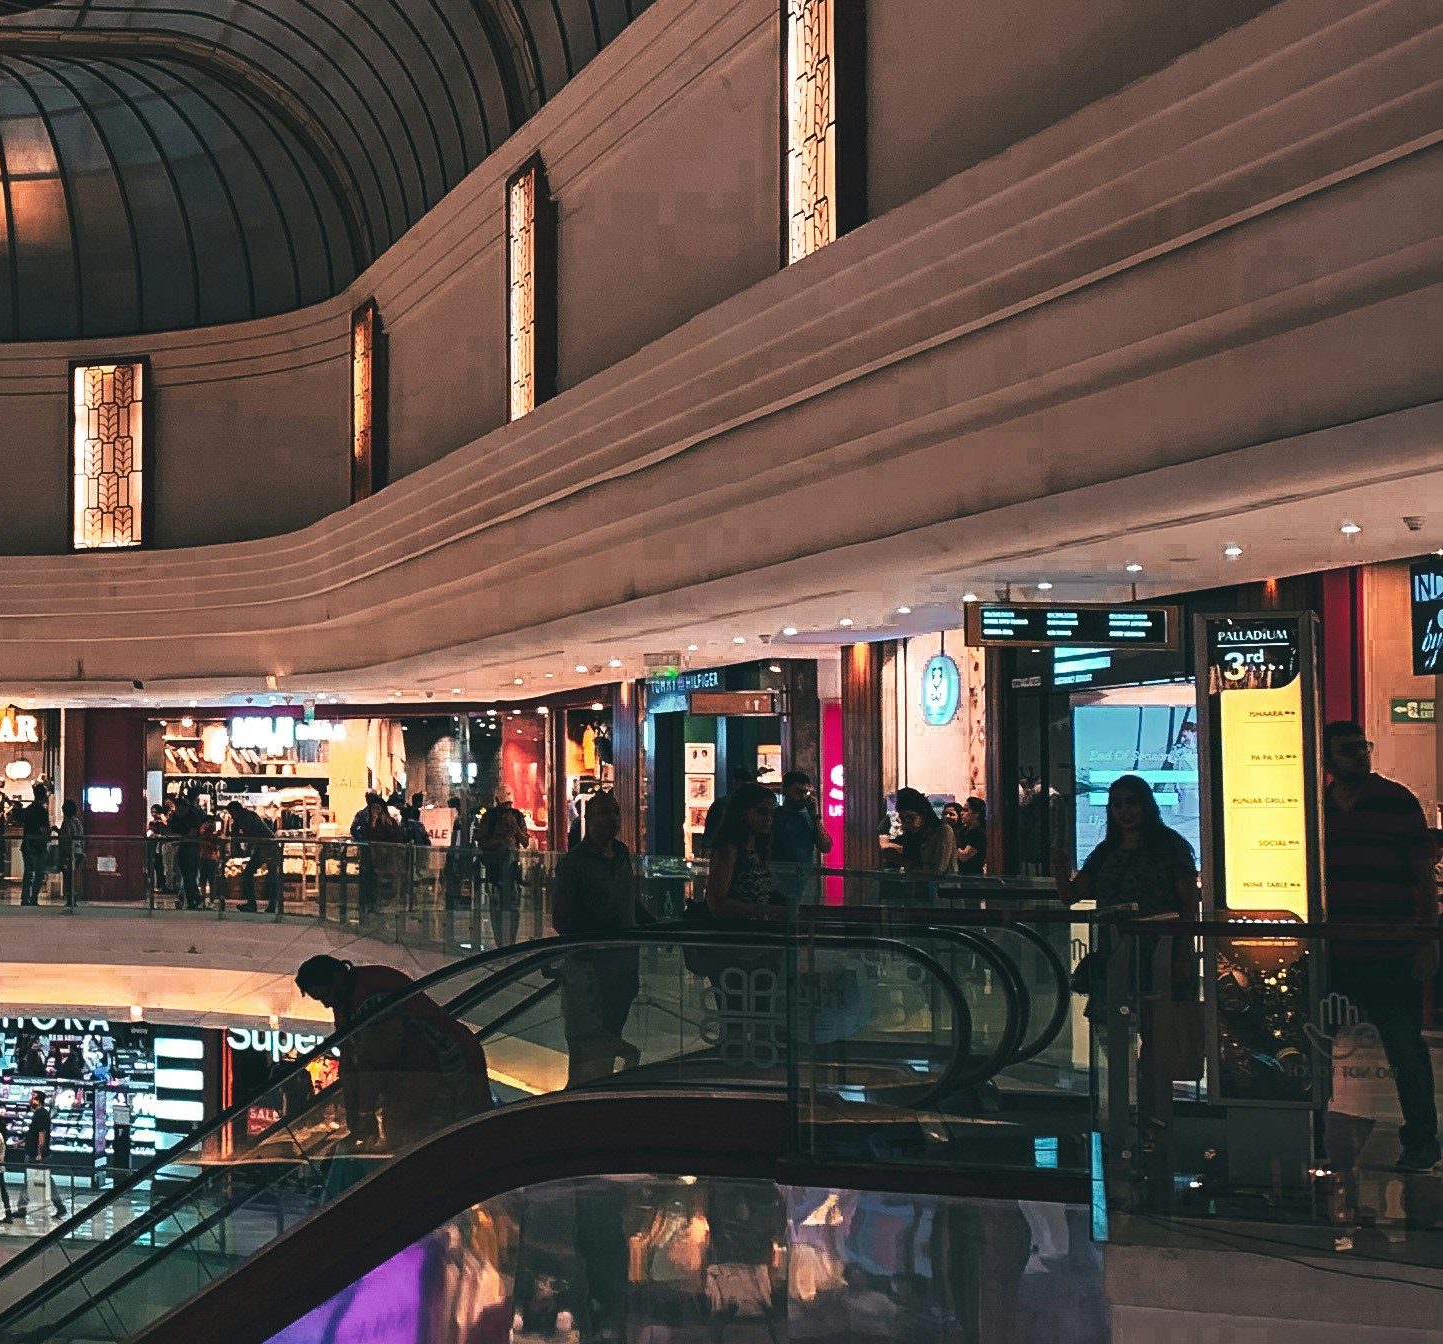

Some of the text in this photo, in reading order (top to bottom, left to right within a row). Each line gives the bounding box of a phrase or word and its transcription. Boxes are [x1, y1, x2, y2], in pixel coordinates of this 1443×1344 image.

[1217, 630, 1288, 642] PALLADIUM
[1223, 649, 1264, 680] 3rd
[685, 671, 719, 689] HILFIGER
[427, 829, 448, 840] ALE
[227, 1028, 340, 1062] Supe
[249, 1107, 281, 1121] SALE
